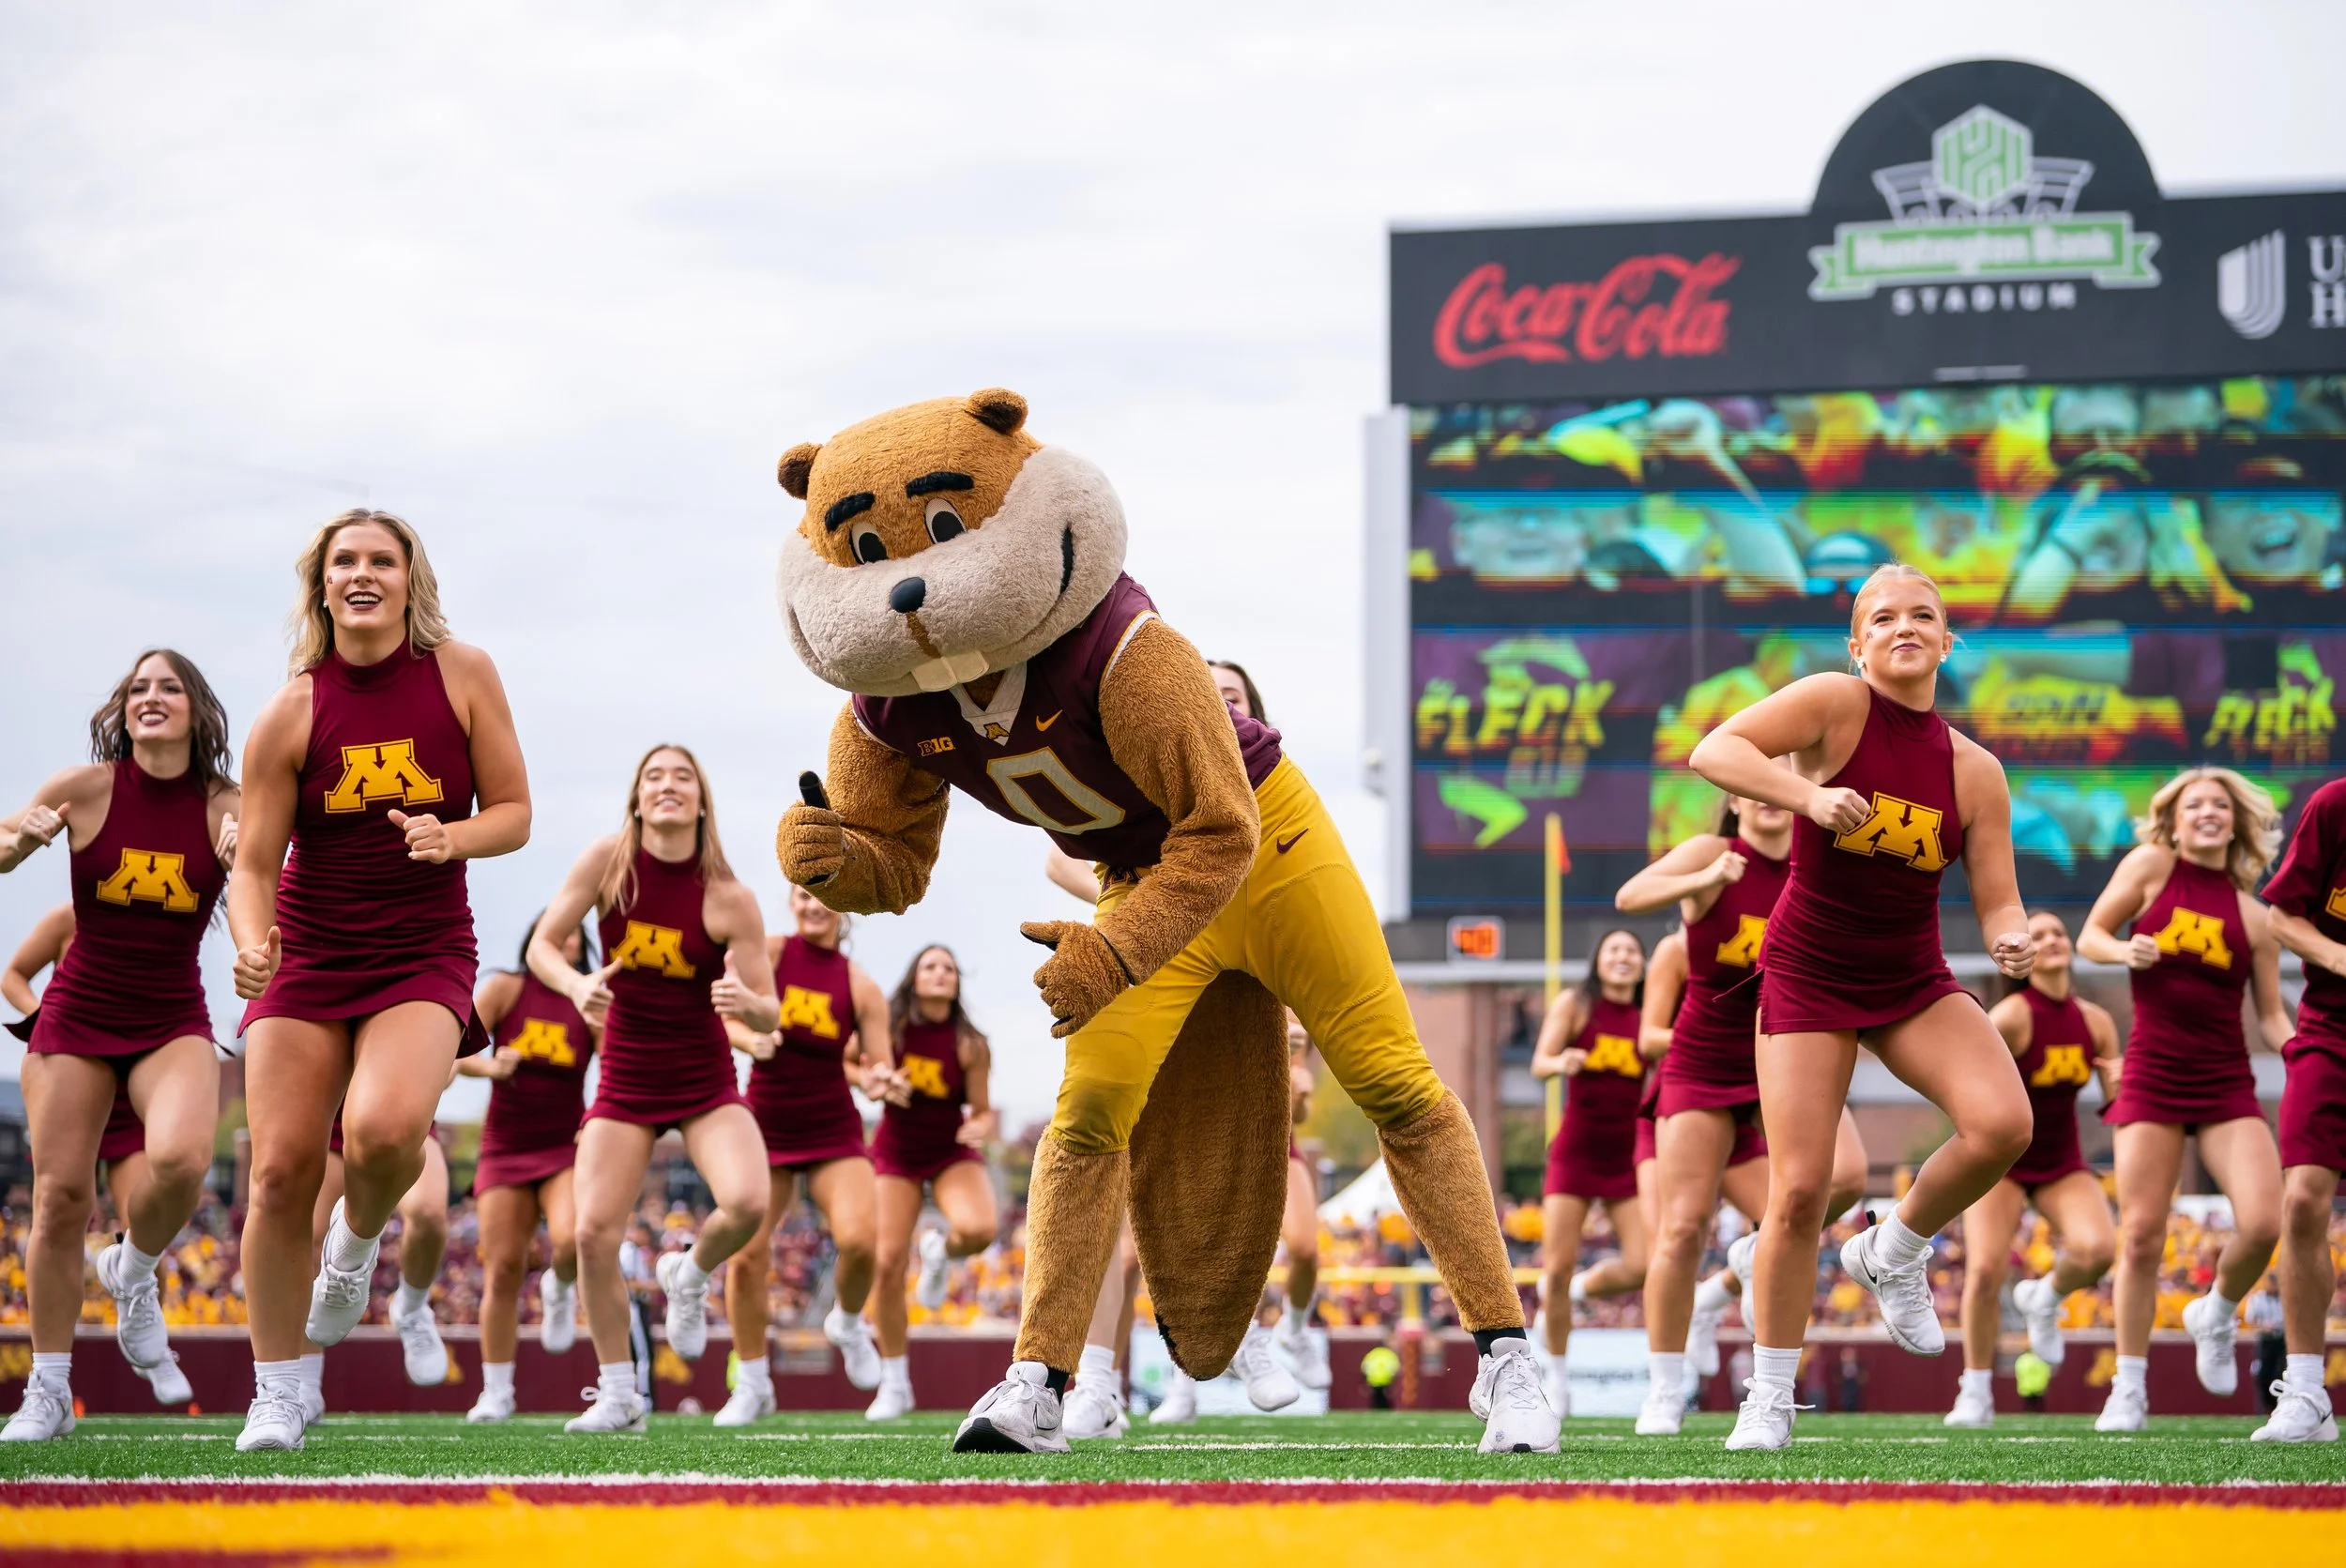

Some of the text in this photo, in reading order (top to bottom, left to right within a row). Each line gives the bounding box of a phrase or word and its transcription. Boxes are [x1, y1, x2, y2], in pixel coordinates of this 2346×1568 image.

[1891, 282, 2077, 316] STADIUM
[325, 738, 443, 814] M
[986, 746, 1126, 835] 0
[1834, 791, 1948, 872] M
[97, 847, 199, 912] M
[610, 920, 696, 979] M
[2154, 906, 2233, 970] M
[509, 1016, 576, 1066] M
[780, 984, 840, 1040] M
[1585, 1033, 1642, 1077] M
[2030, 1043, 2092, 1087] M
